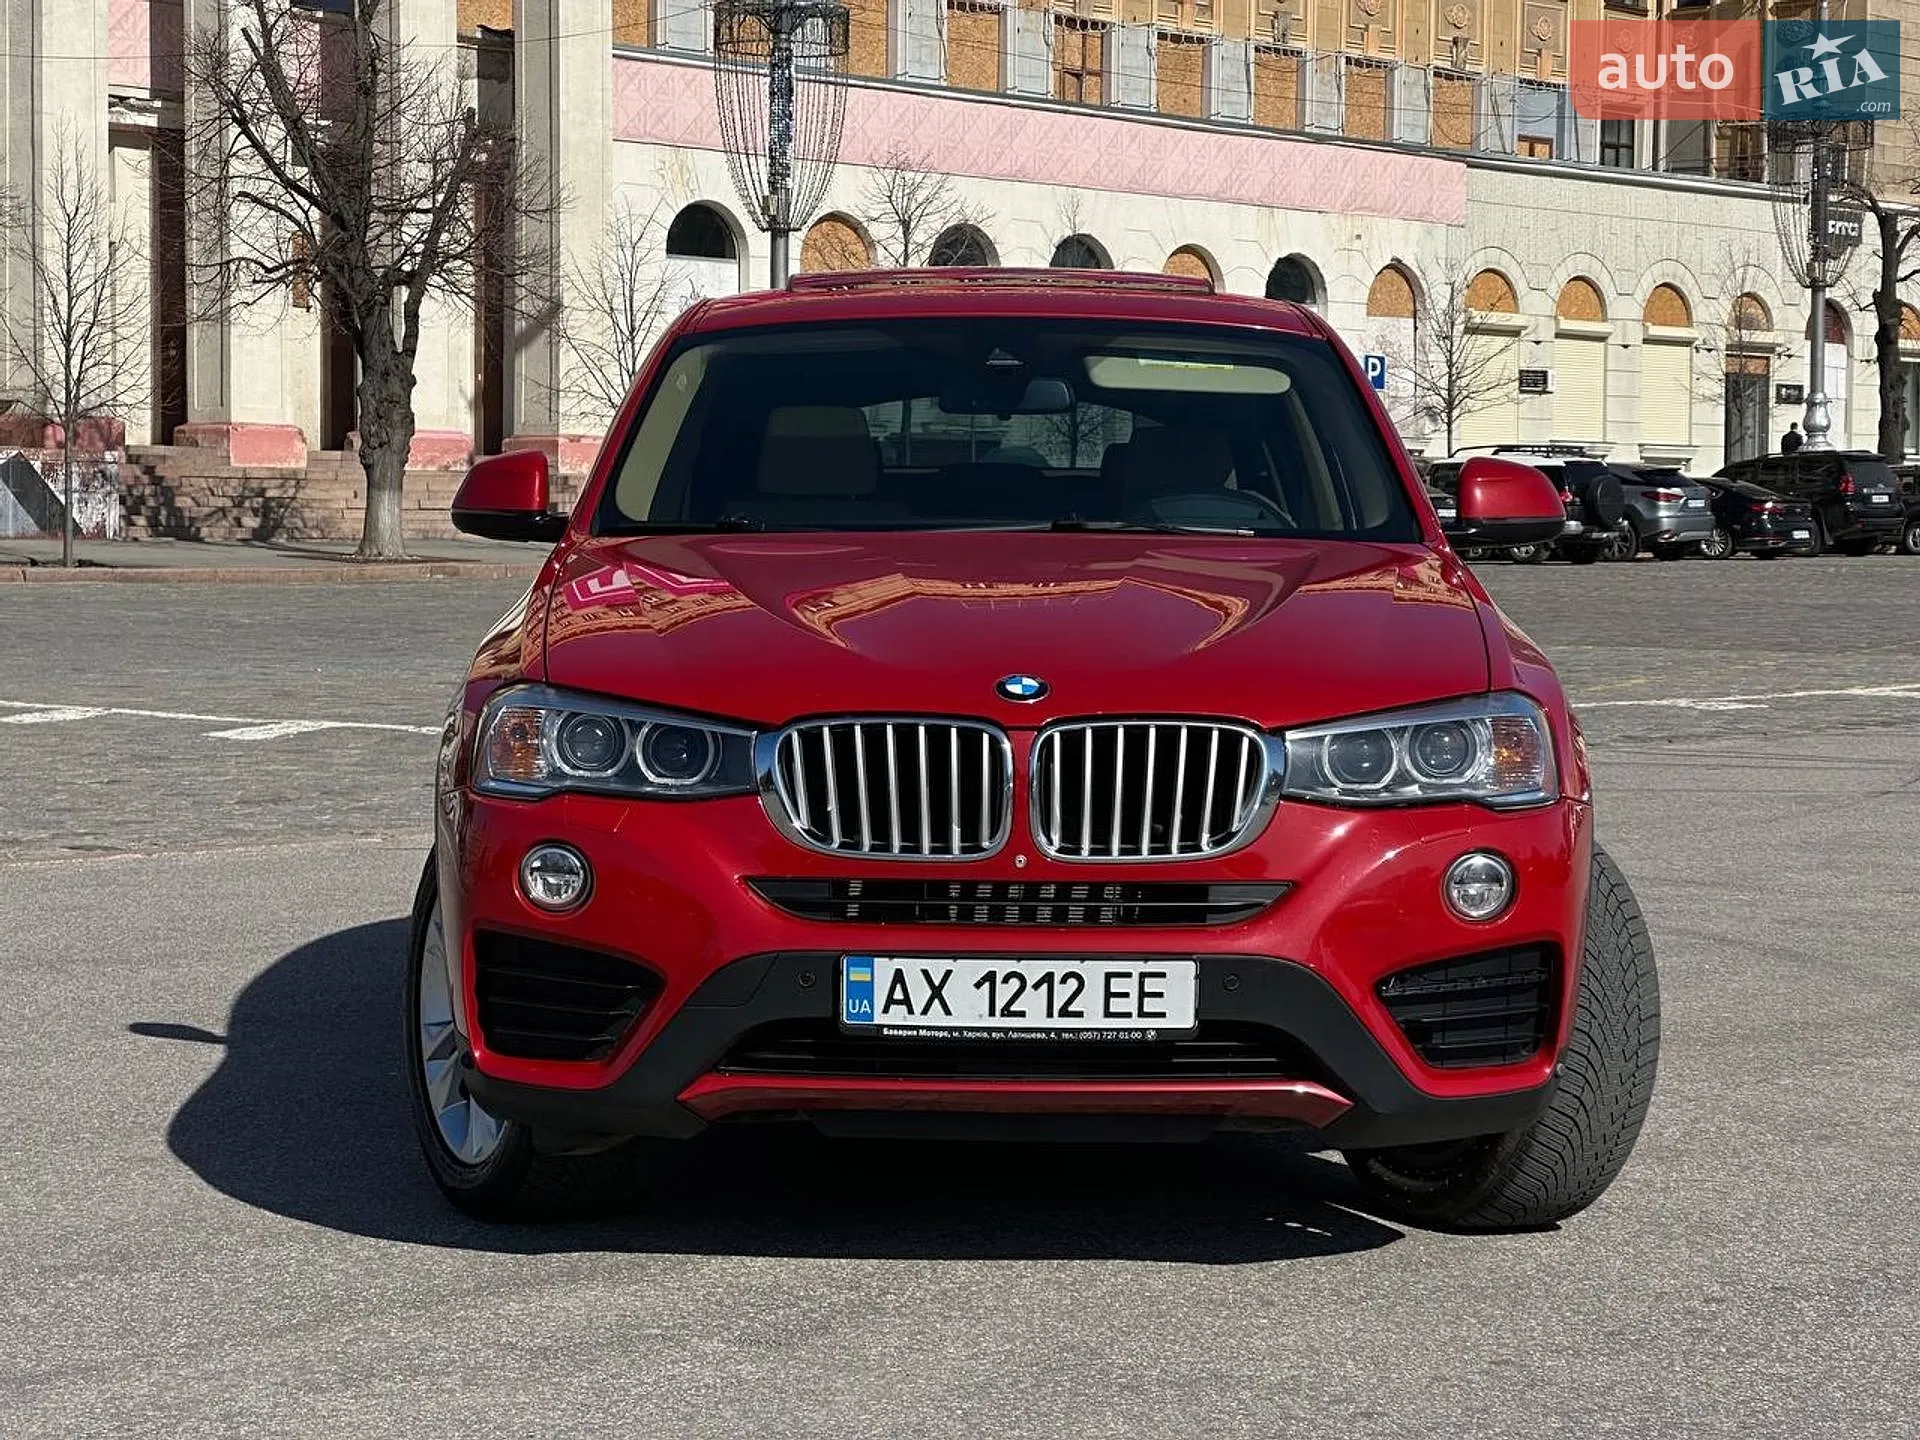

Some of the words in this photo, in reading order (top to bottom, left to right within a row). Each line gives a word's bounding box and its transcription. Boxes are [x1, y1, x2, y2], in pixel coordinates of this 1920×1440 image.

[1368, 357, 1381, 382] P
[882, 968, 954, 1016] AX
[973, 970, 1085, 1018] 1212
[1104, 971, 1166, 1018] EE
[849, 999, 871, 1014] UA
